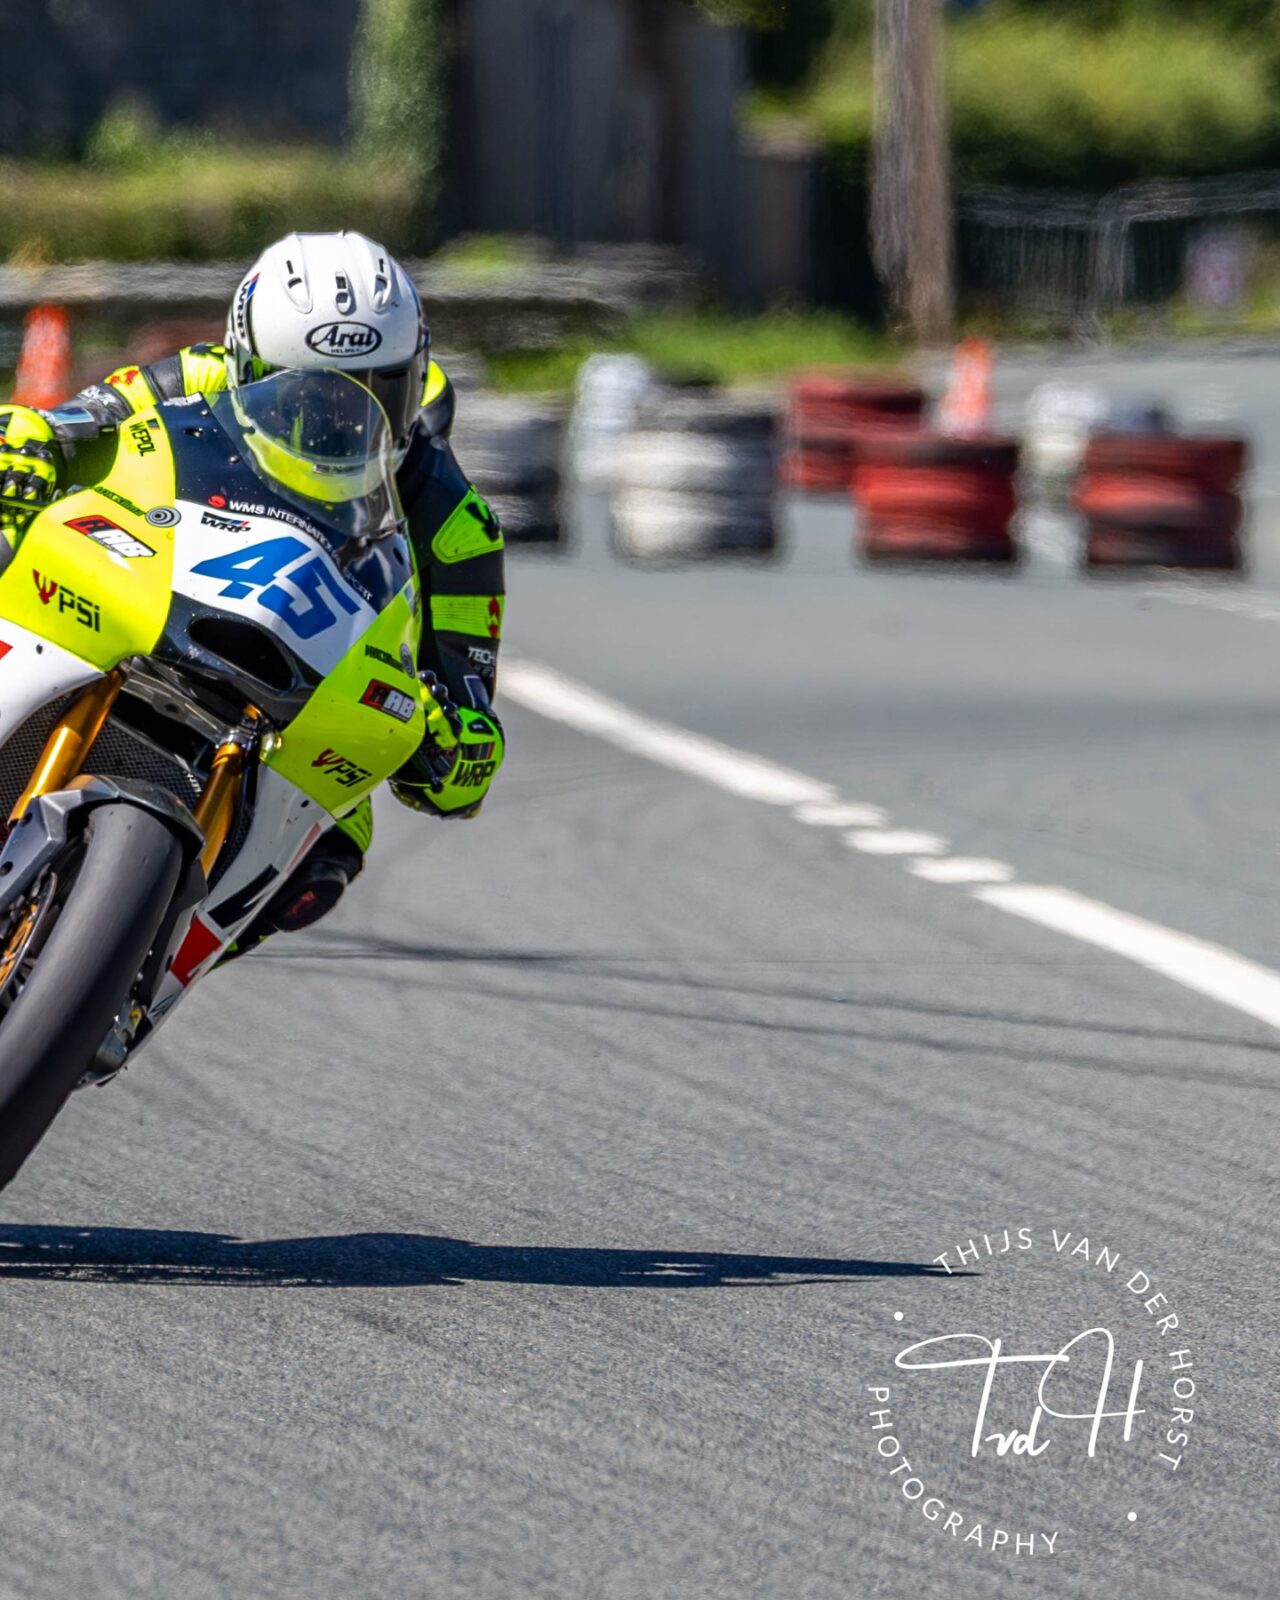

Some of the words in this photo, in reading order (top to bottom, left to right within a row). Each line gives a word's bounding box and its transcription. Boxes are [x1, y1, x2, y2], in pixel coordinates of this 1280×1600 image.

[312, 325, 375, 347] Arai
[129, 420, 156, 456] WEPOL
[229, 500, 265, 515] WMS
[190, 536, 361, 640] 45
[451, 761, 496, 787] WRP
